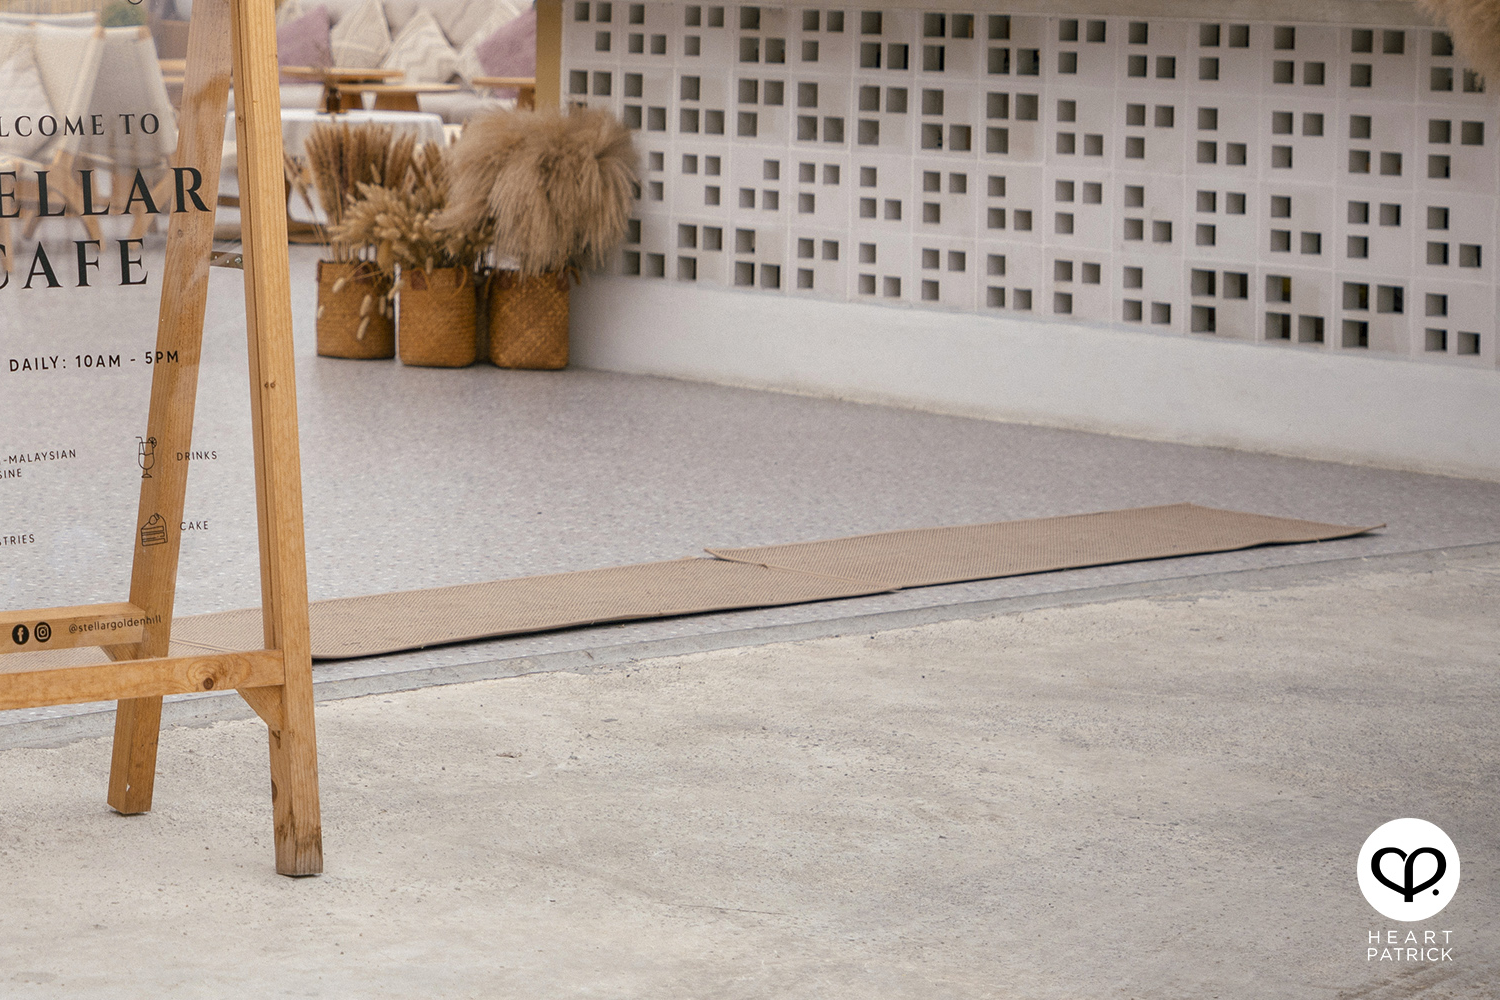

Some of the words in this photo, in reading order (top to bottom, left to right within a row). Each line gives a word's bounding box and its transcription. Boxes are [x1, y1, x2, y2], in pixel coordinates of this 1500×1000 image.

[119, 112, 160, 135] TO
[9, 355, 66, 372] DAILY:
[75, 354, 121, 368] 10AM
[145, 350, 179, 365] 5PM
[176, 451, 218, 461] DRINKS
[179, 520, 209, 531] CAKE
[69, 615, 162, 634] @stellargoldenhill
